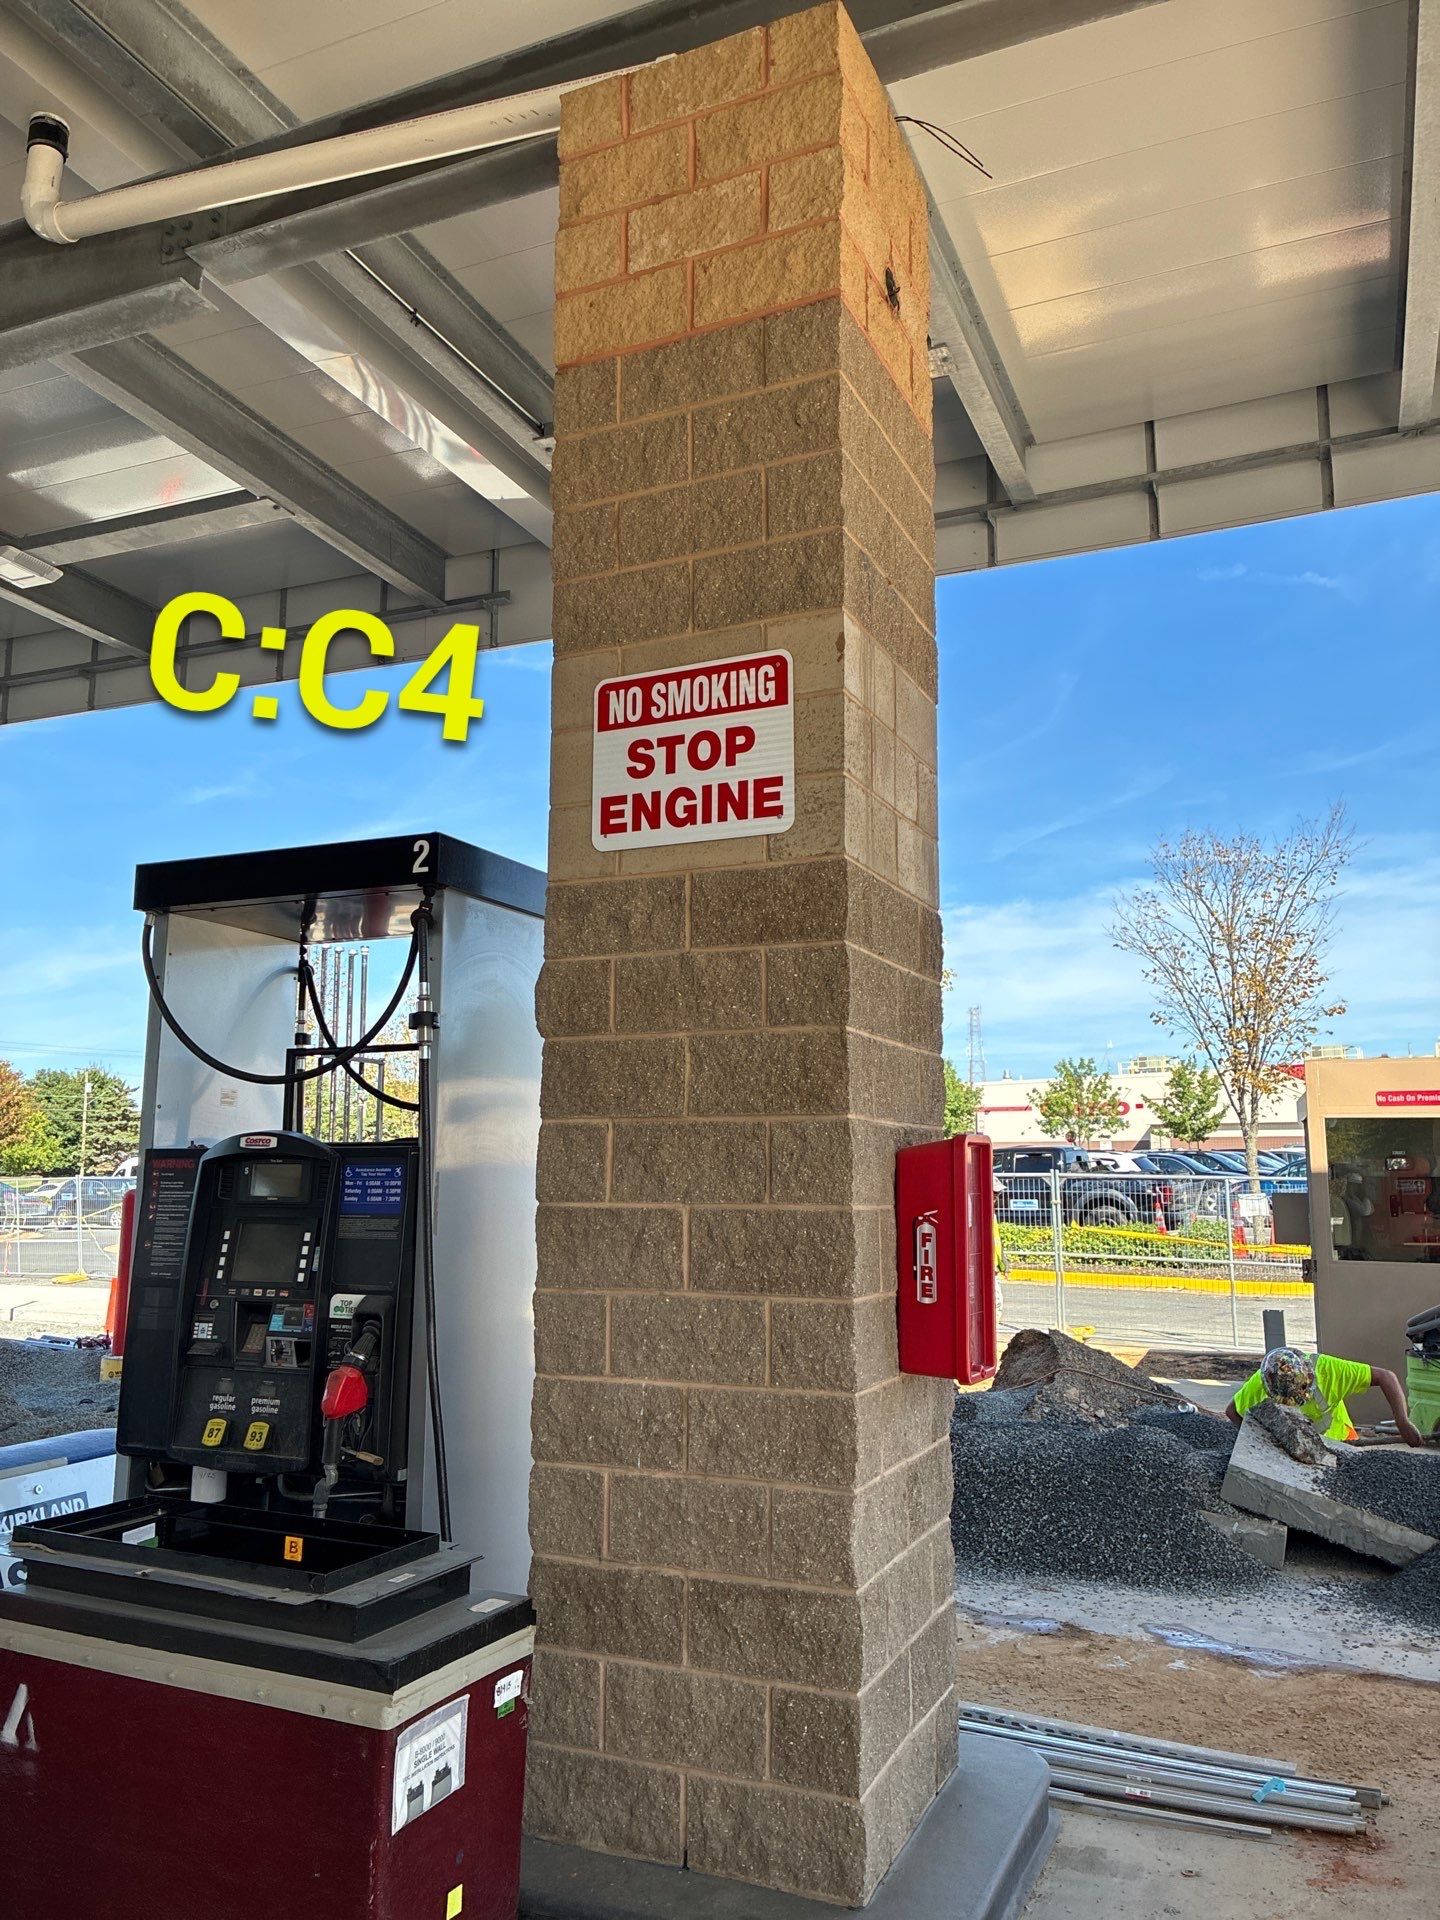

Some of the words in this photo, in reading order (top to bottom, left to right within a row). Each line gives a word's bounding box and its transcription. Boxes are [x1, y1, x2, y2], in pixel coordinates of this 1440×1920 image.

[608, 686, 643, 725] NO
[651, 664, 776, 719] SMOKING
[626, 725, 756, 780] STOP
[600, 776, 784, 835] ENGINE
[412, 839, 430, 873] 2
[1376, 1094, 1387, 1102] No
[1387, 1094, 1405, 1102] Cash
[1406, 1094, 1416, 1102] On
[152, 1160, 196, 1169] WARNING
[921, 1233, 934, 1298] FIRE
[212, 1394, 236, 1403] regular
[251, 1397, 281, 1406] premium
[209, 1402, 236, 1411] gasoline
[251, 1406, 279, 1414] gasoline
[207, 1427, 221, 1439] 87
[249, 1431, 263, 1443] 93
[0, 1497, 86, 1532] KIRKLAND
[290, 1541, 298, 1553] B
[411, 1760, 434, 1779] INSTALLATION
[434, 1744, 456, 1763] INSTRUCTIONS
[413, 1751, 433, 1769] SINGLE
[433, 1742, 447, 1756] WALL
